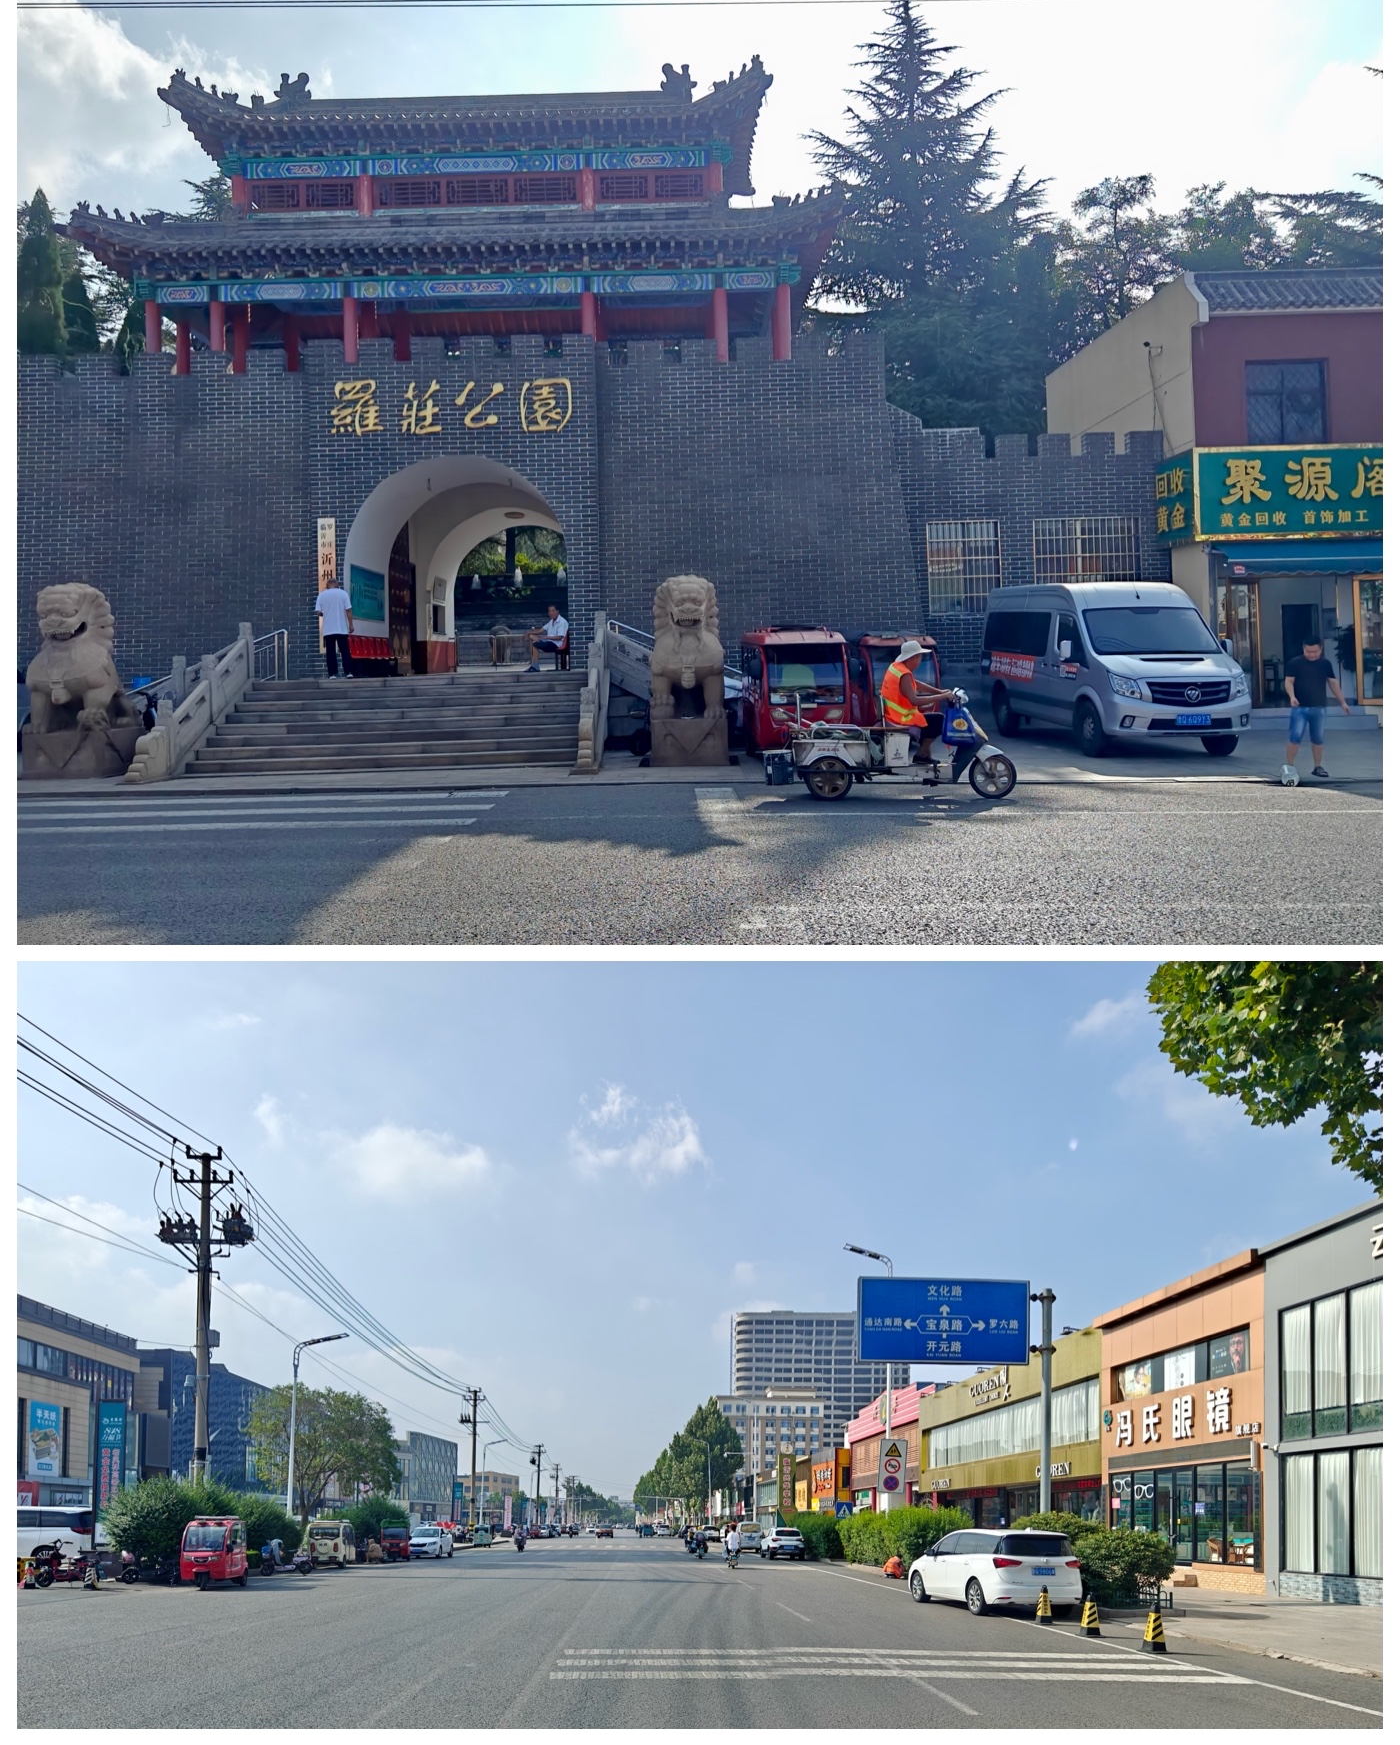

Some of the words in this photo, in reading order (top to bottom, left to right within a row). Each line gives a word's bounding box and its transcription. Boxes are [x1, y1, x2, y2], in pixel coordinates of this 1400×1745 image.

[1155, 467, 1184, 499] 回收
[1156, 502, 1186, 534] 黄金
[1220, 511, 1287, 527] 黄金回收
[1303, 509, 1369, 525] 首饰加工
[927, 1284, 962, 1297] 文化路
[864, 1317, 903, 1327] 通达南路
[926, 1318, 963, 1332] 宝泉路
[989, 1319, 1019, 1330] 罗六路
[926, 1341, 962, 1353] 开元路
[969, 1375, 1000, 1397] GUOREN
[1116, 1387, 1231, 1448] 冯氏眼镜
